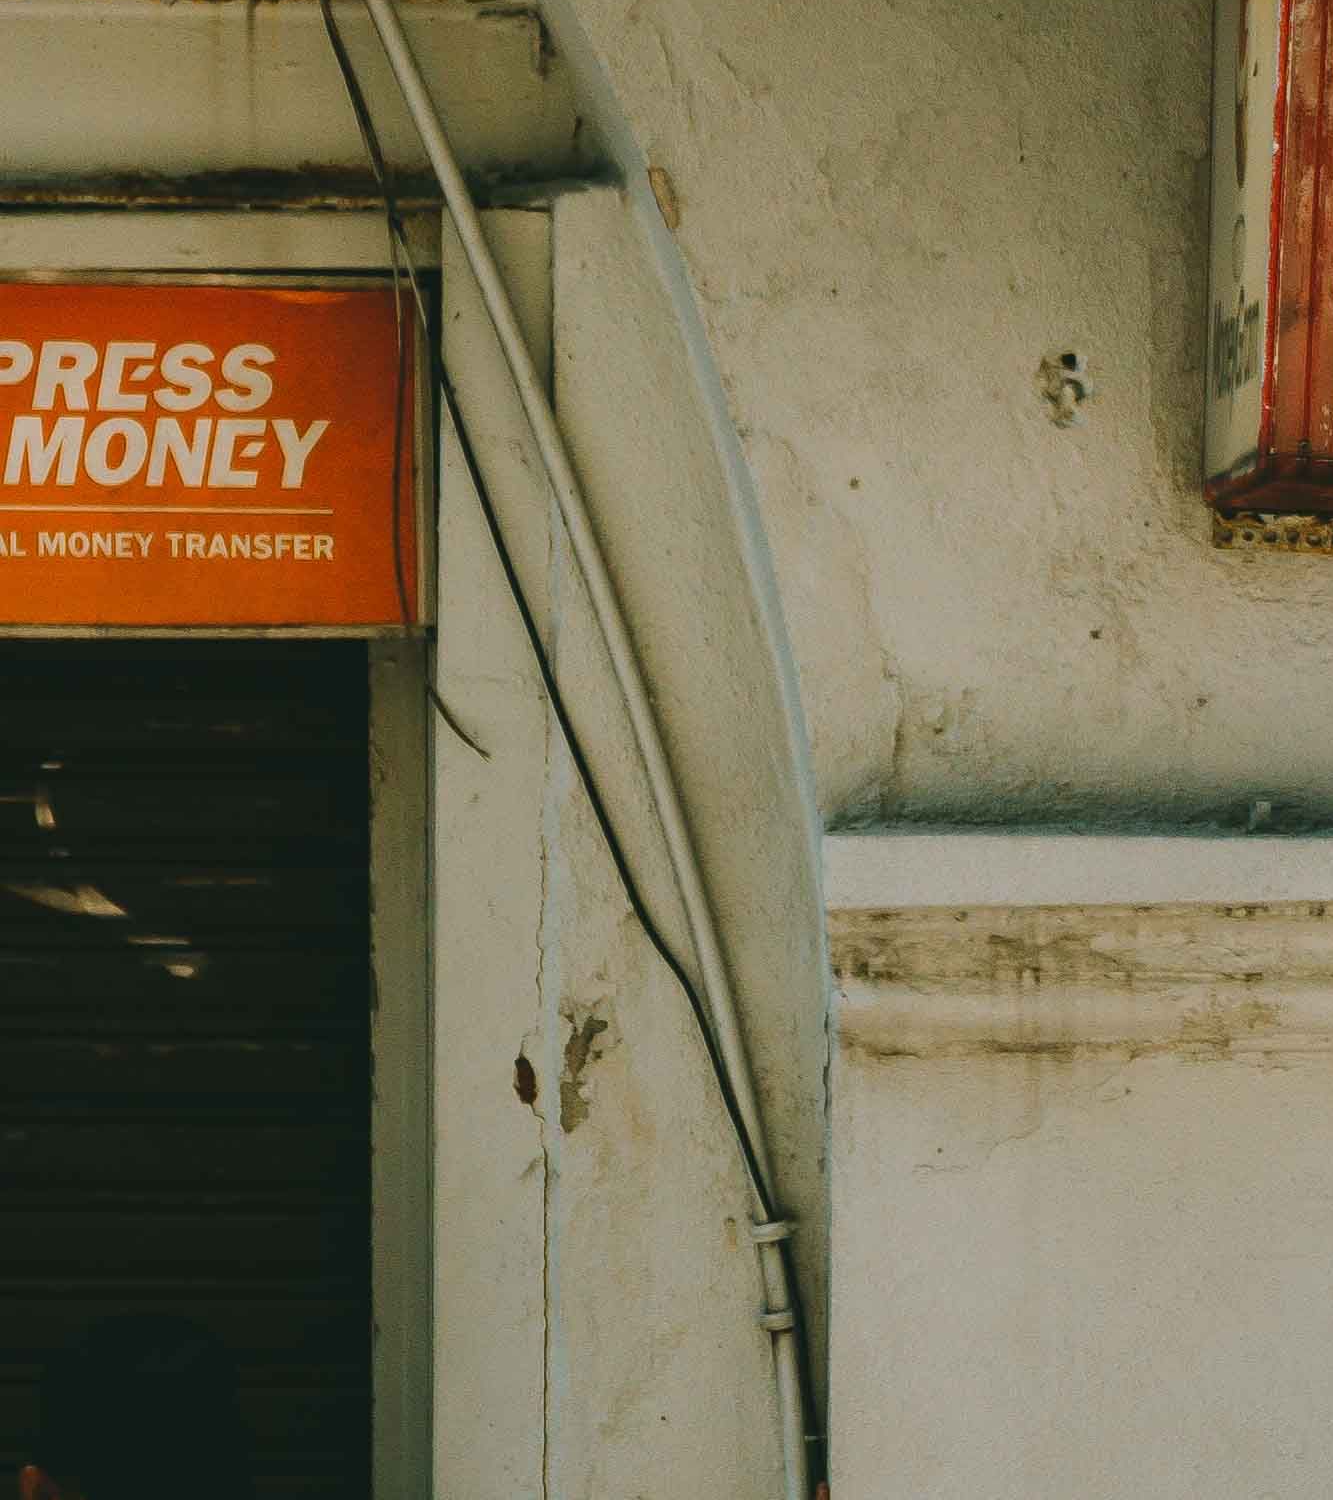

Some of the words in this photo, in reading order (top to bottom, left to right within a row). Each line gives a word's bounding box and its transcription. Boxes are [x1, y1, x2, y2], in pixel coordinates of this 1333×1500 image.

[3, 415, 330, 489] MONEY
[37, 530, 154, 560] MONEY
[165, 532, 334, 562] TRANSFER
